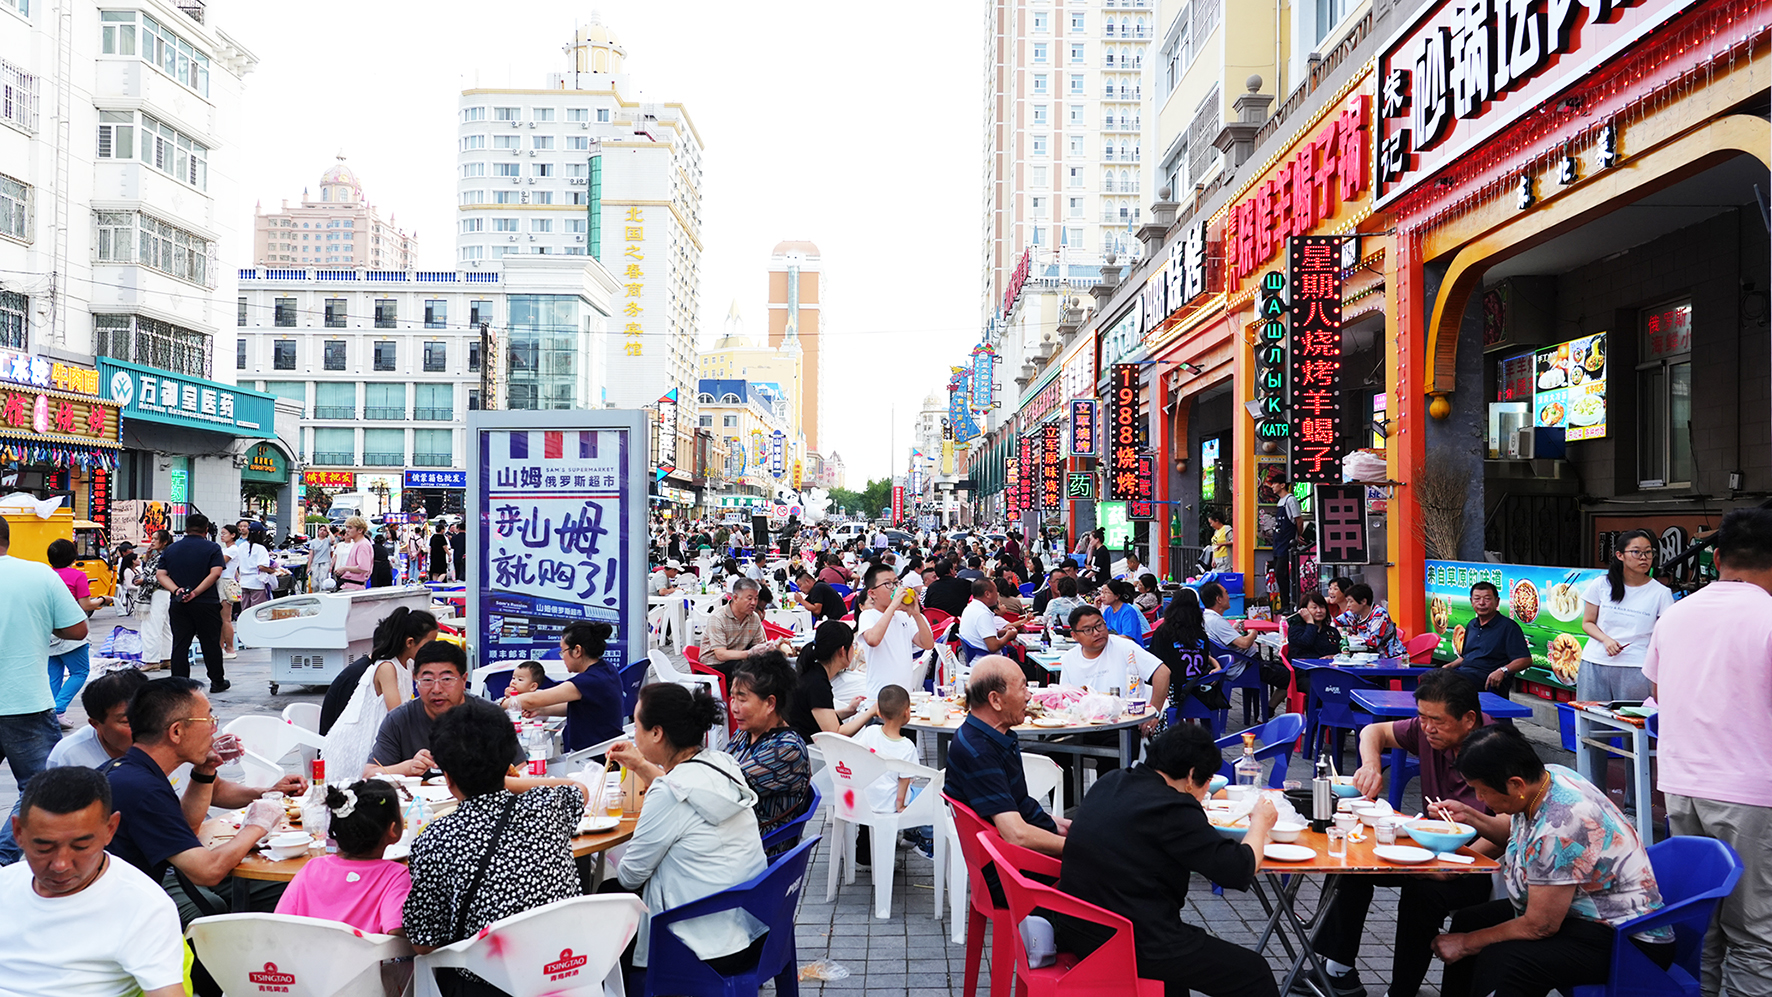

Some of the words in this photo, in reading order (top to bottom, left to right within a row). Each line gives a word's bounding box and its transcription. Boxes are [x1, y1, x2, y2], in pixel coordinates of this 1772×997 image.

[1238, 95, 1363, 278] 烧烤羊蝎子锅
[623, 206, 645, 356] 北国之春商务宾馆
[1648, 306, 1692, 334] 俄罗斯
[1267, 274, 1283, 413] ШАШЛЫК
[1651, 328, 1692, 355] 海鲜小
[1301, 245, 1333, 472] 星期八烧烤羊蝎子
[51, 362, 99, 396] 牛肉面
[1116, 369, 1137, 495] 1988烧烤
[1262, 423, 1289, 437] КАТЯ
[497, 466, 542, 488] 山姆
[1045, 425, 1057, 507] 立军原味烧烤
[545, 475, 615, 488] 俄罗斯超市
[1069, 474, 1091, 497] 药
[1107, 506, 1127, 547] 药店
[1324, 490, 1363, 559] 串
[1428, 565, 1503, 592] 来自草原的味道
[536, 603, 583, 616] 山姆俄罗斯超市
[489, 650, 527, 659] 顺丰邮寄
[1181, 653, 1204, 677] 20
[252, 974, 293, 983] TSINGTAO
[547, 957, 585, 973] TSINGTAO
